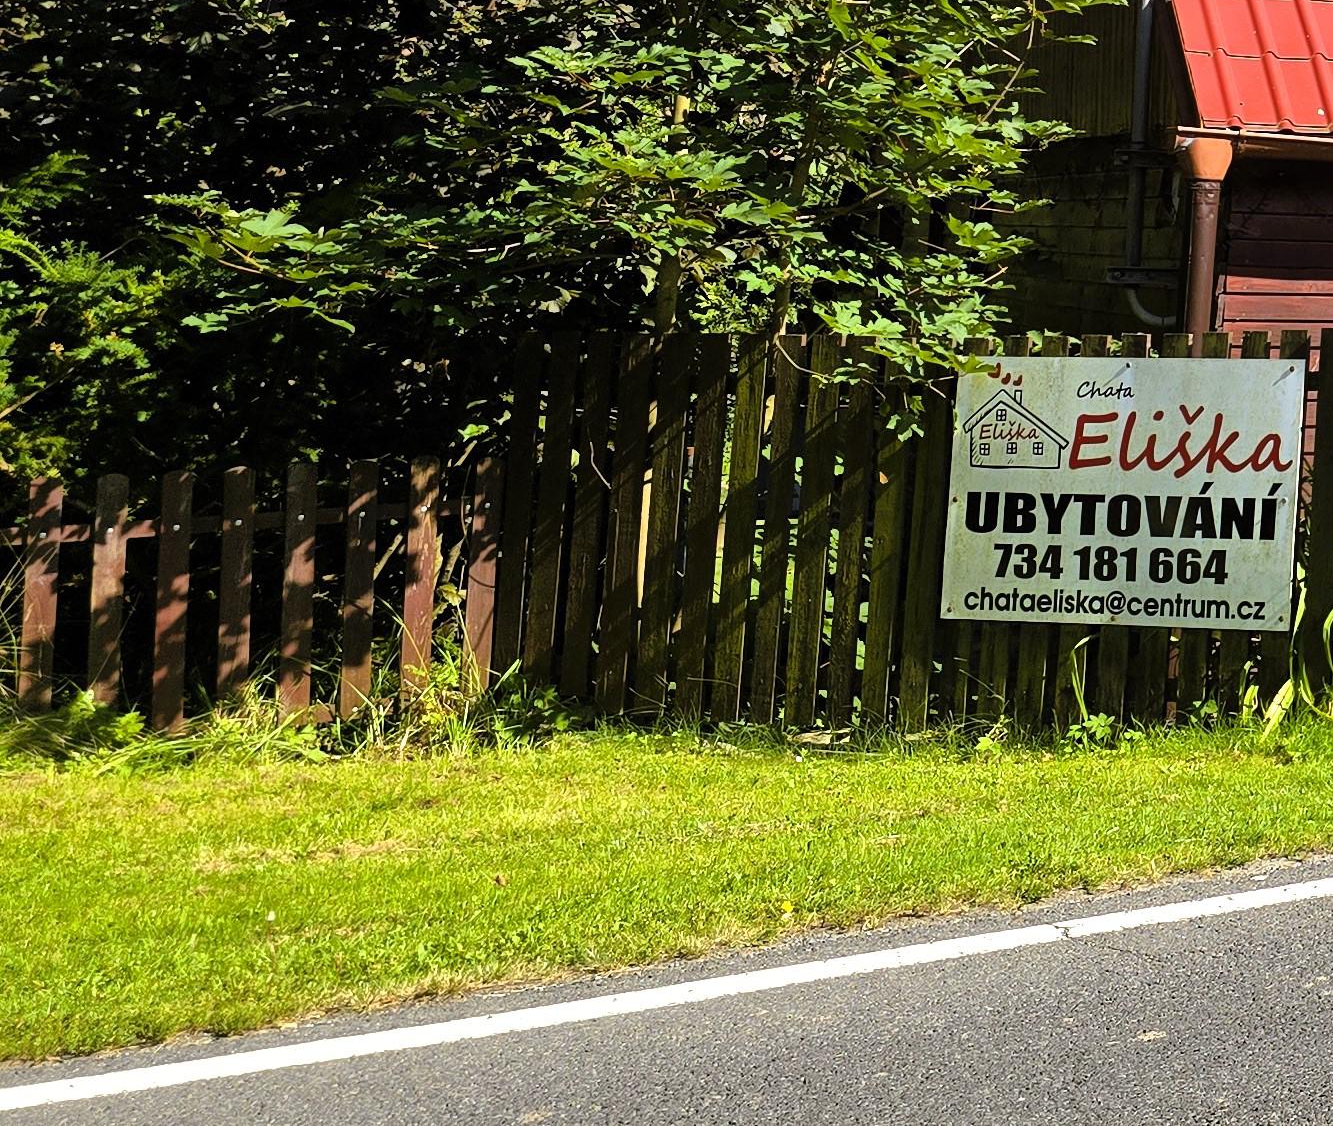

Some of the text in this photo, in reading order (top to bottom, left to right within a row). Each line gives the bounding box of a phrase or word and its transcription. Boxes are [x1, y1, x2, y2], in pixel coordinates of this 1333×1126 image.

[1077, 382, 1134, 399] Chata
[979, 422, 1040, 441] Eliška
[1069, 405, 1292, 478] Eliška
[966, 482, 1282, 540] UBYTOVÁNÍ
[994, 543, 1228, 584] 734 181 664
[964, 587, 1265, 620] chataeliska@centrum.cz
